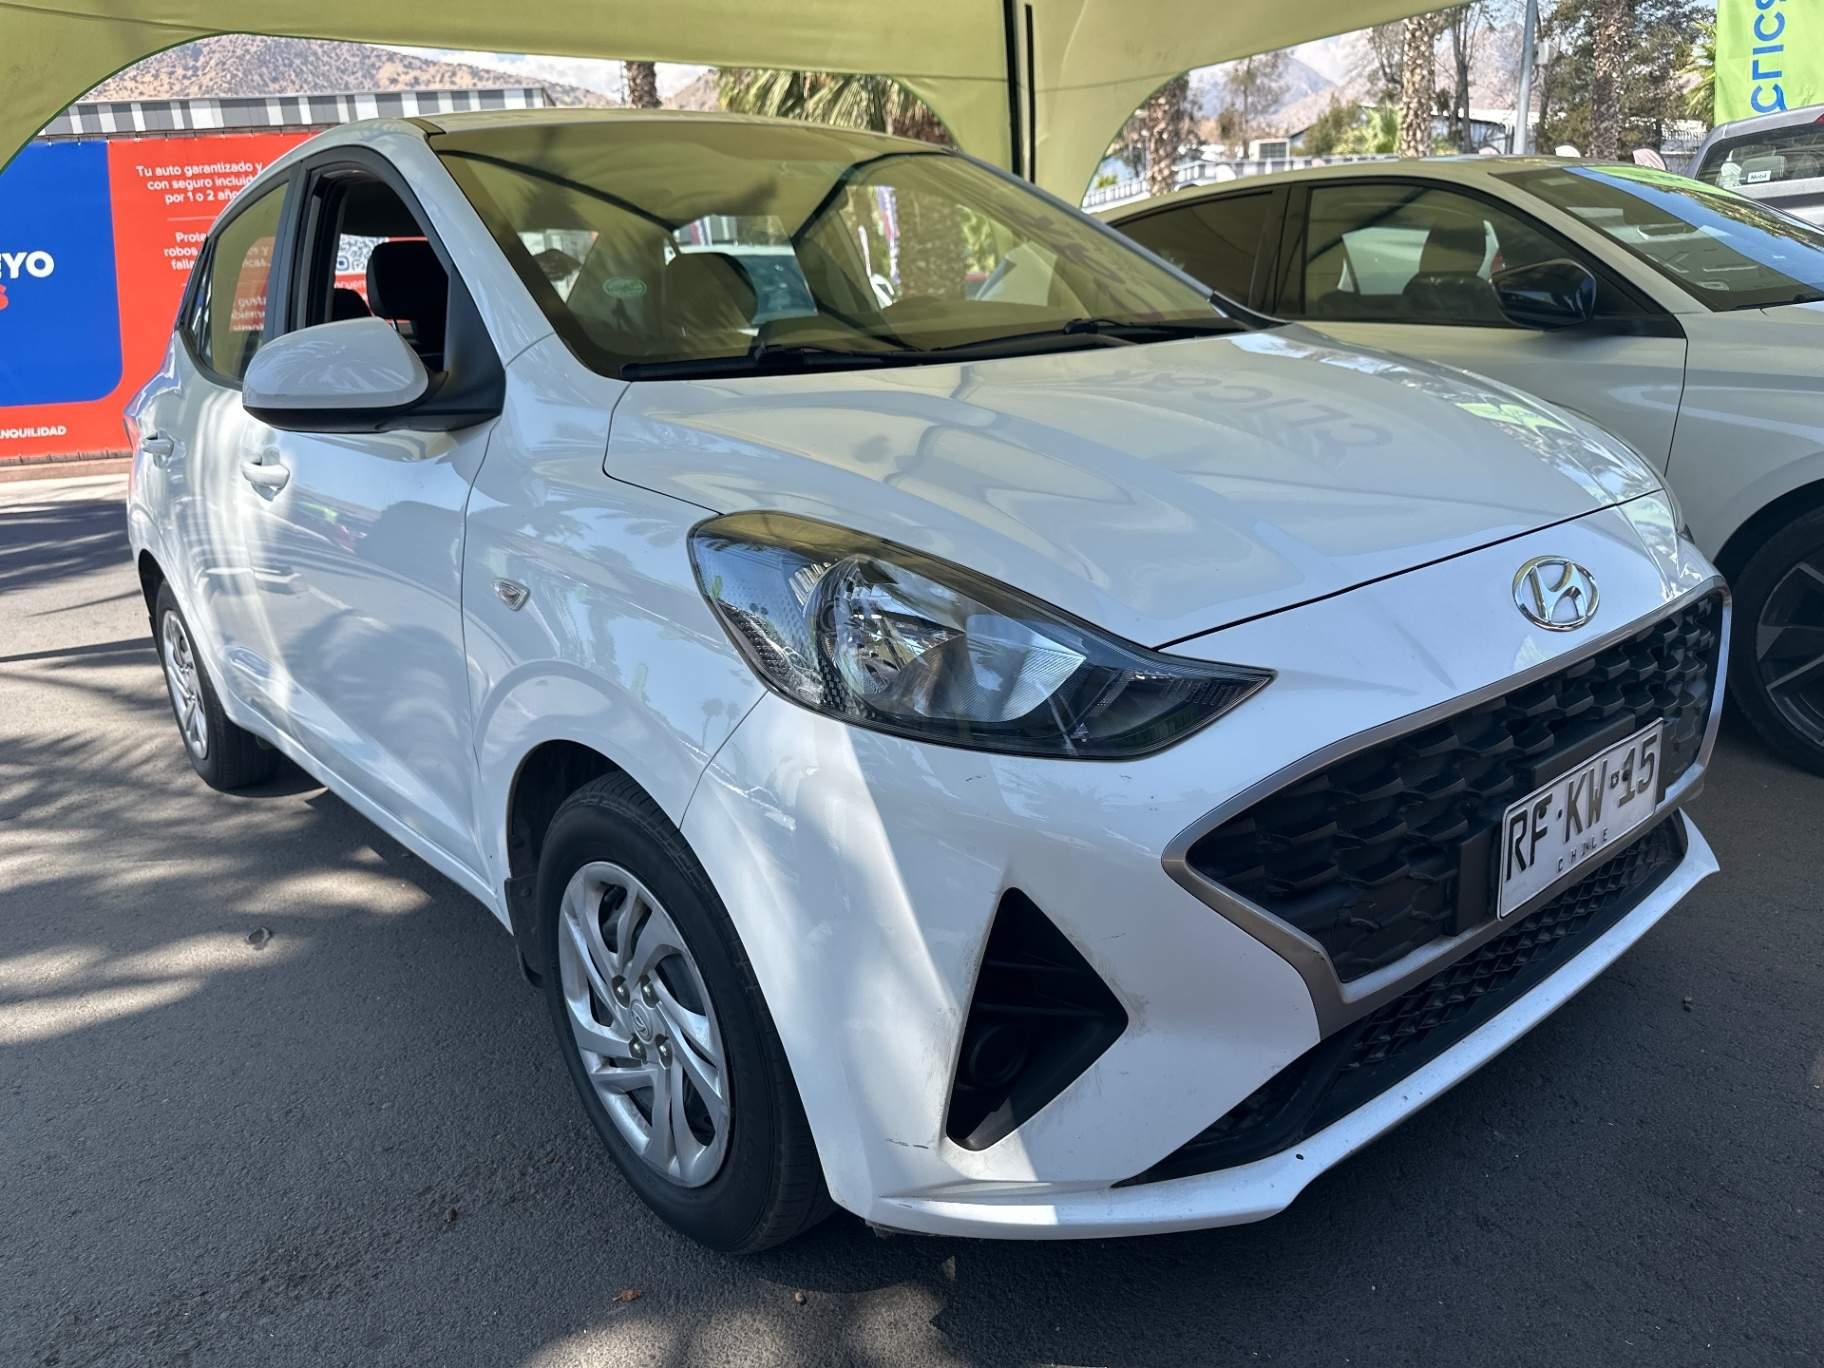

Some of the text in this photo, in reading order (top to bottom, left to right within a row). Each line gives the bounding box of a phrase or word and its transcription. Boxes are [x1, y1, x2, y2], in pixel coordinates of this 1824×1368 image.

[136, 165, 152, 176] Tu
[155, 166, 181, 176] auto
[184, 161, 253, 177] garantizado
[147, 175, 255, 191] con seguro incluid
[165, 193, 184, 204] por
[187, 191, 193, 201] 1
[206, 190, 215, 201] 2
[218, 190, 238, 200] año
[175, 232, 207, 243] Prote
[164, 246, 198, 257] robos
[0, 251, 55, 279] YO
[0, 426, 67, 439] NQUILIDAD
[1557, 827, 1608, 873] CHILE
